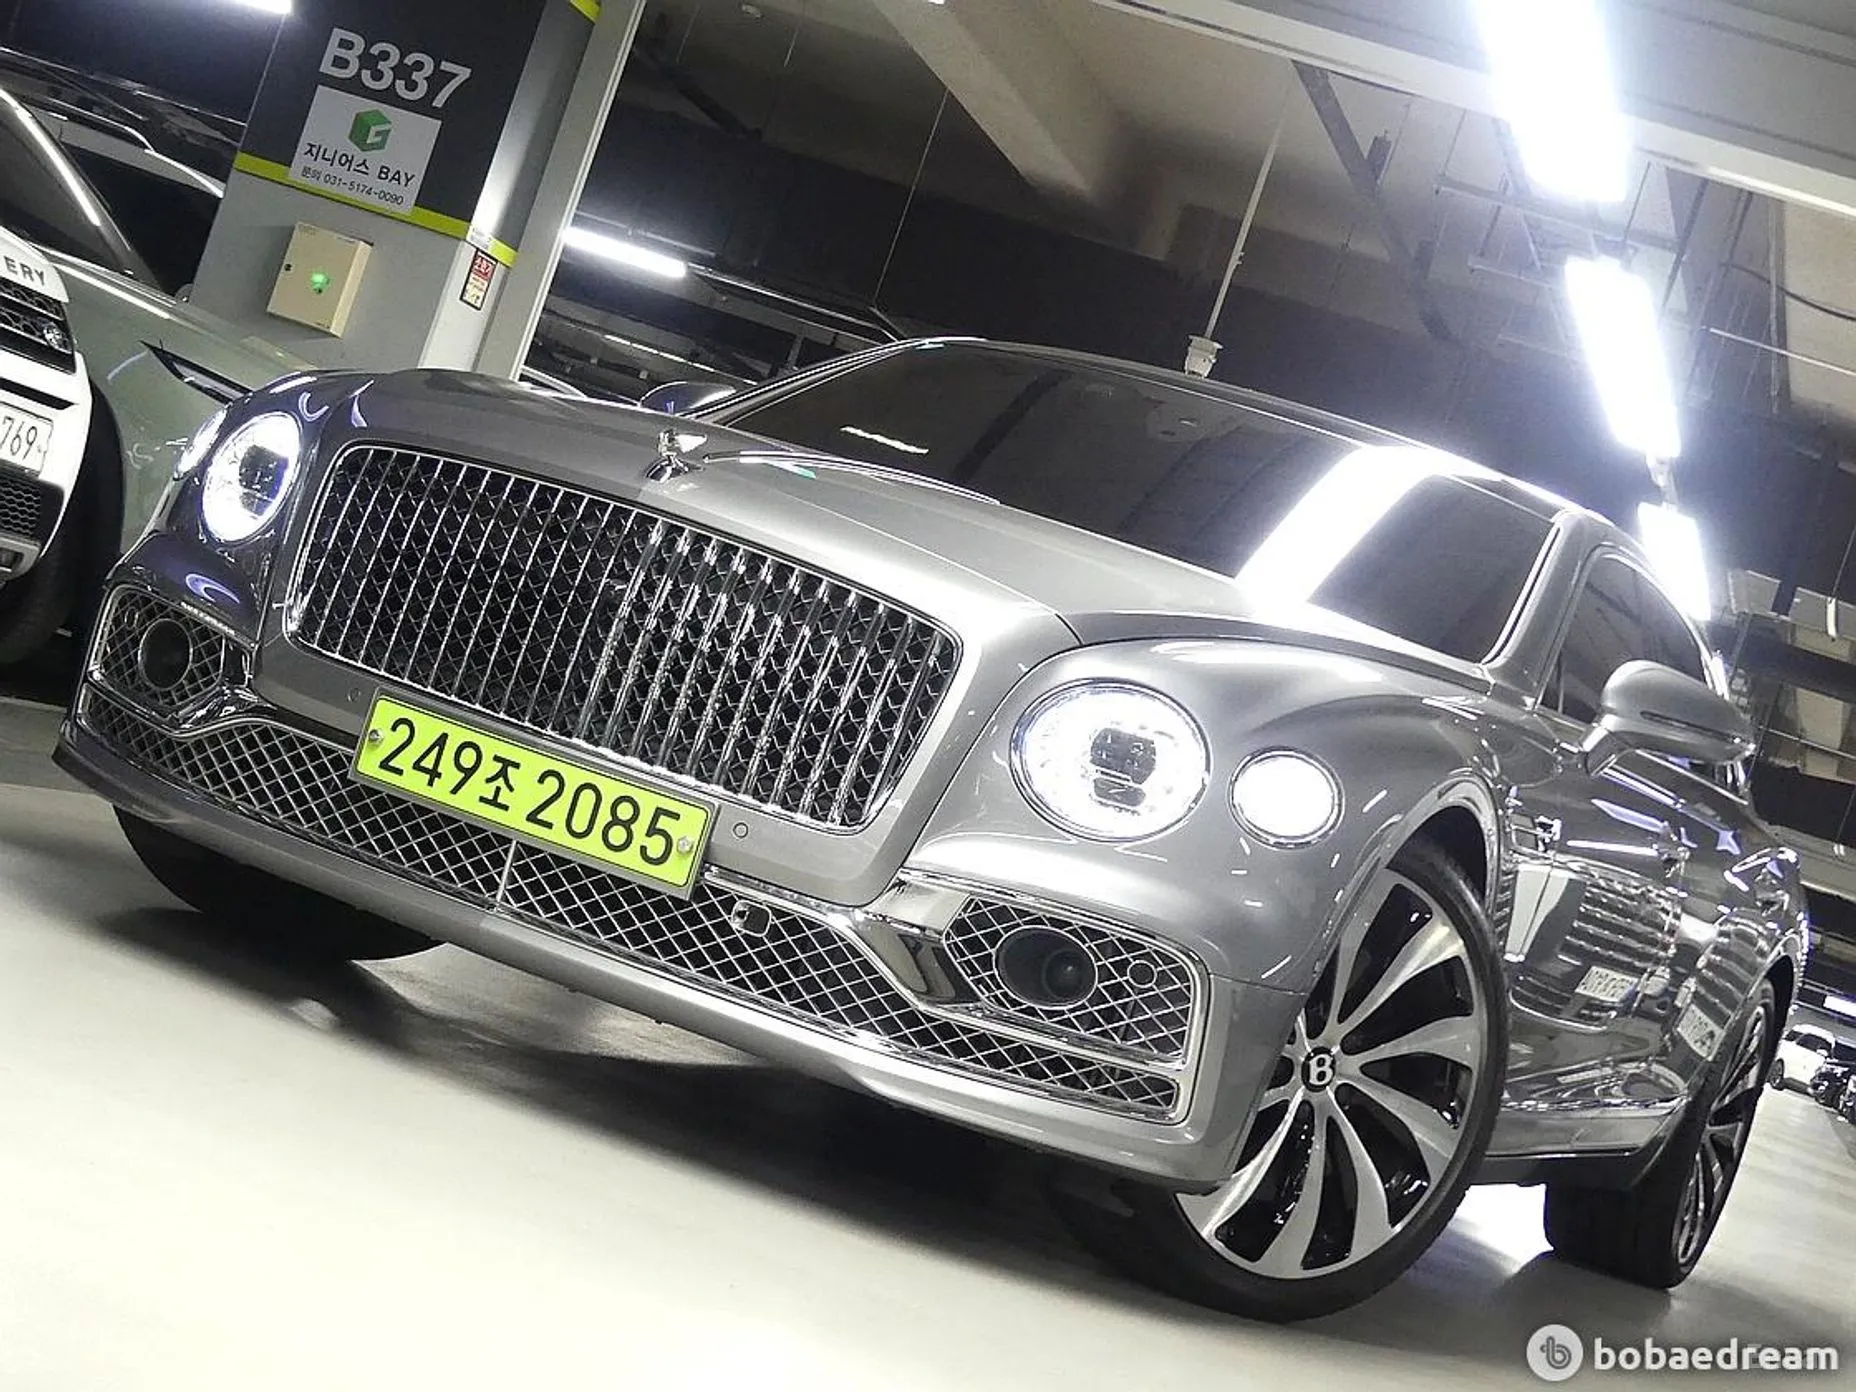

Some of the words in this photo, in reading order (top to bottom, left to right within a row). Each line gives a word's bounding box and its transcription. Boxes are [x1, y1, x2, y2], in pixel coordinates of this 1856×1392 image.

[318, 27, 472, 108] B337
[303, 142, 370, 176] 지니어스
[377, 165, 416, 188] BAY
[3, 255, 46, 287] ERY
[379, 717, 522, 812] 249조
[525, 769, 681, 866] 2085
[1308, 1053, 1334, 1086] B
